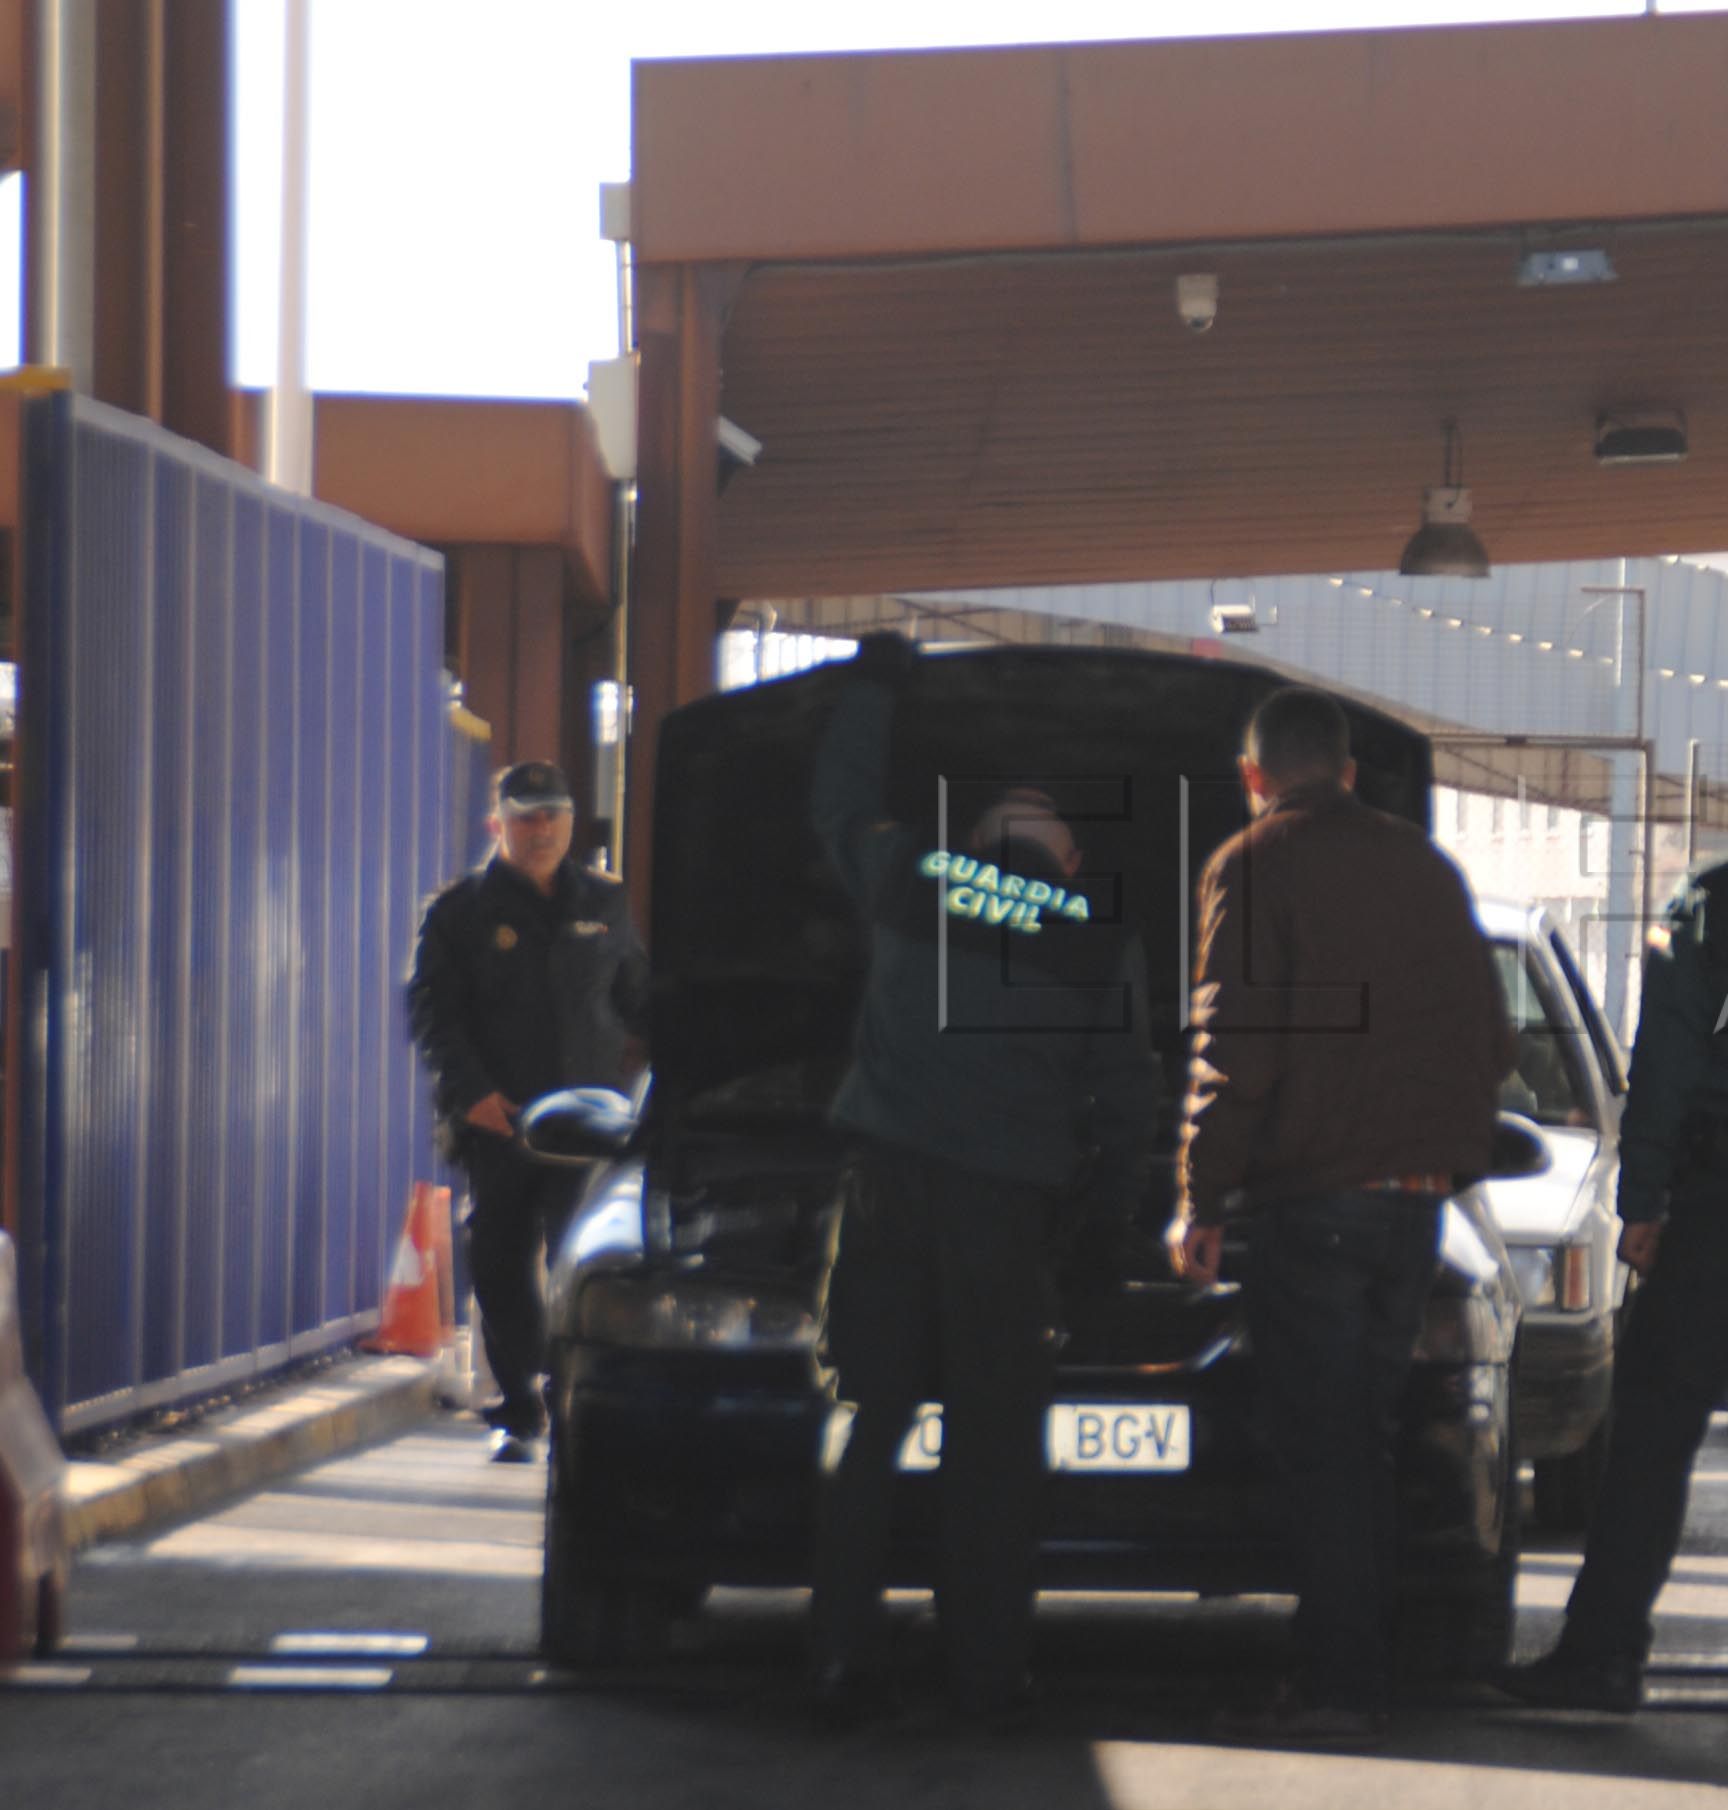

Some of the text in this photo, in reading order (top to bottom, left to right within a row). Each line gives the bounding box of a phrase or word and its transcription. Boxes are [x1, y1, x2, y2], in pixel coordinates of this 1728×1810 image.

[919, 850, 1090, 922] GUARDIA
[947, 886, 1043, 934] CIVIL
[1076, 1413, 1176, 1461] BGV
